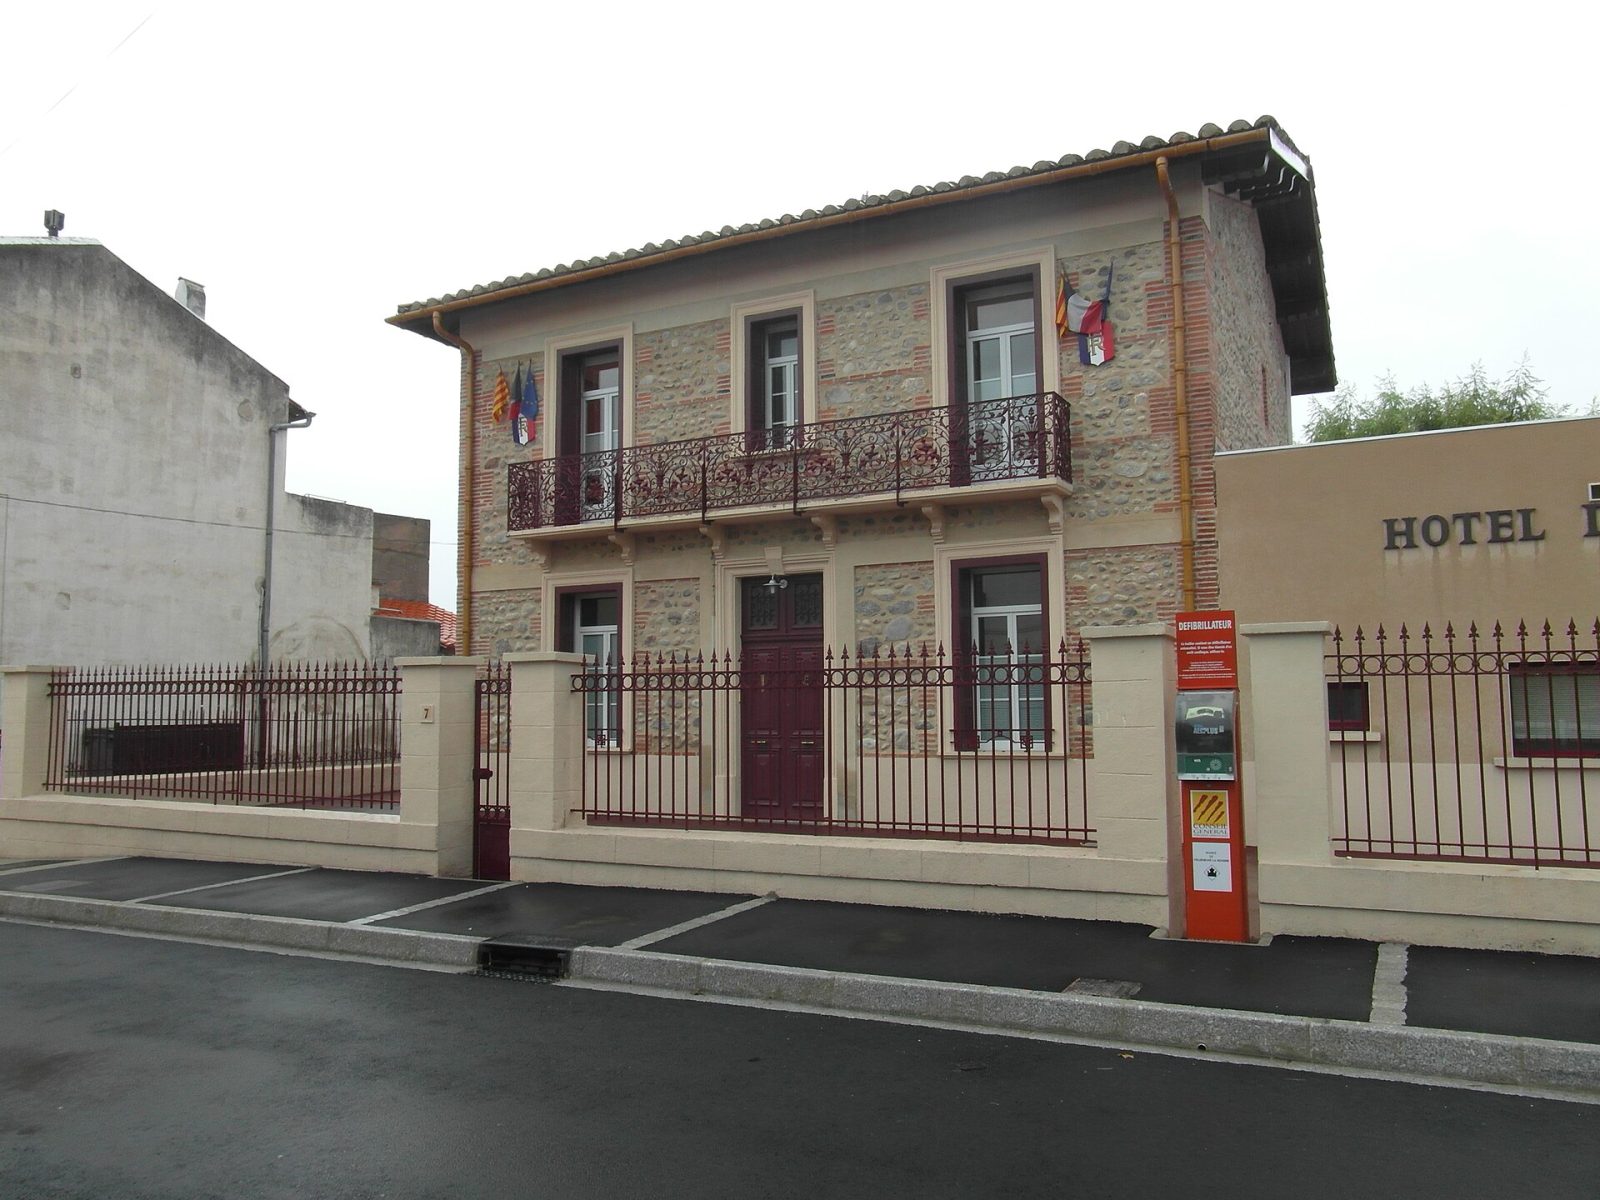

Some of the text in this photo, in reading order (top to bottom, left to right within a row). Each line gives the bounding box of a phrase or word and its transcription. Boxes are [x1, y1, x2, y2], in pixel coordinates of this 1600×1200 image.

[1382, 508, 1546, 551] HOTEL
[1179, 620, 1232, 631] DEFIBRILLATEUR
[424, 708, 429, 719] 7
